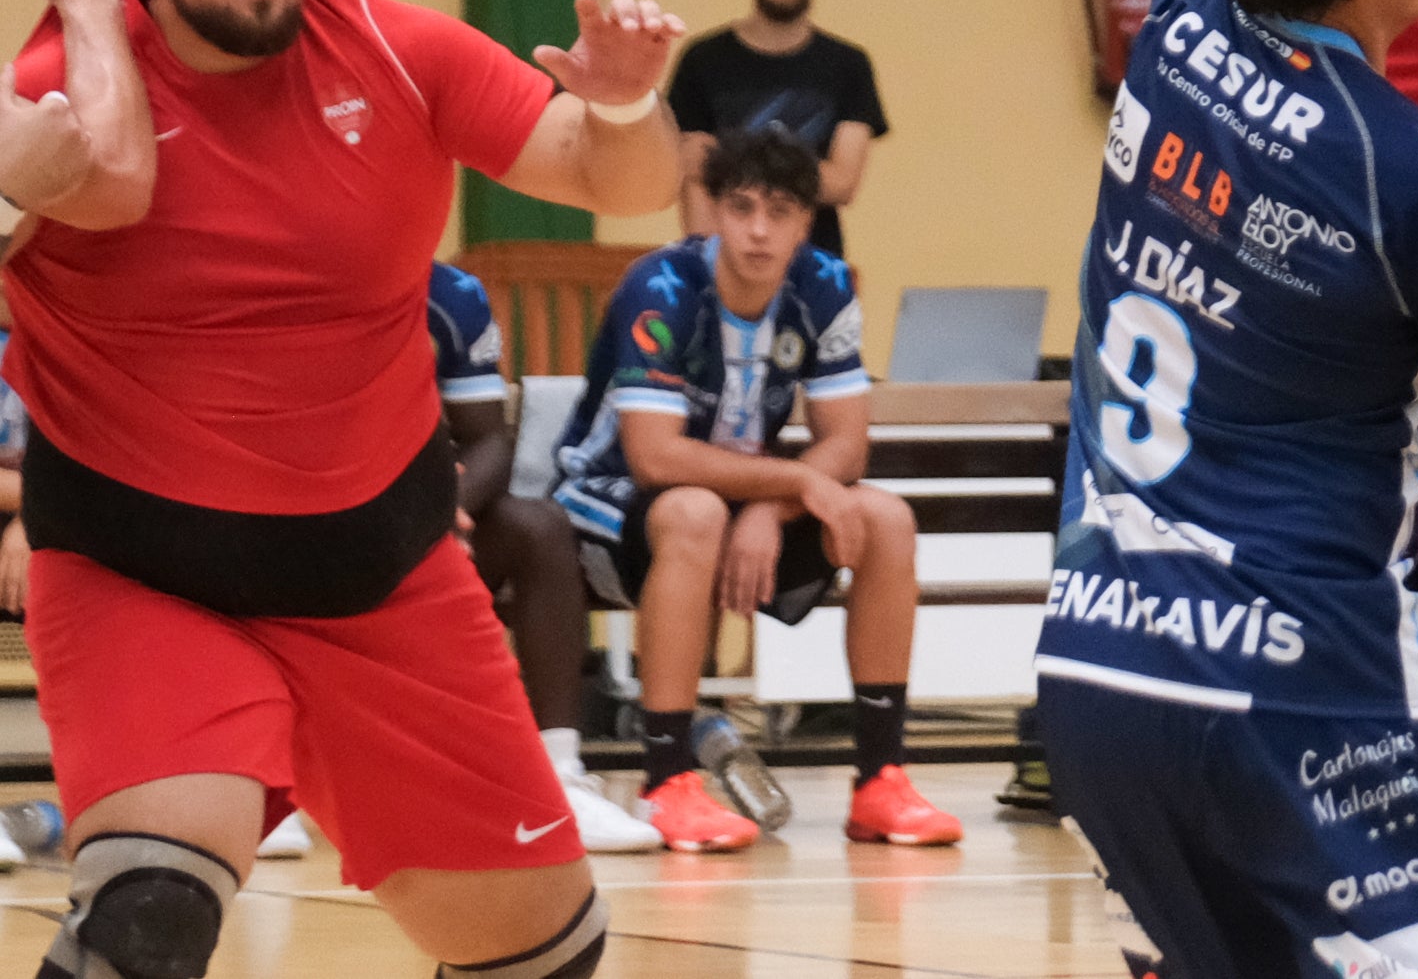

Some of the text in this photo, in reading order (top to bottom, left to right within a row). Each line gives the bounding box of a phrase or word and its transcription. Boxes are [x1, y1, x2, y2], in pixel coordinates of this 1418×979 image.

[1163, 10, 1326, 144] CESUR
[1168, 67, 1212, 108] Centro
[1247, 131, 1267, 152] de
[1267, 141, 1295, 162] FP
[1247, 193, 1357, 253] ANTONIO
[1235, 247, 1323, 298] PROFESIONAL
[1097, 290, 1199, 487] 9
